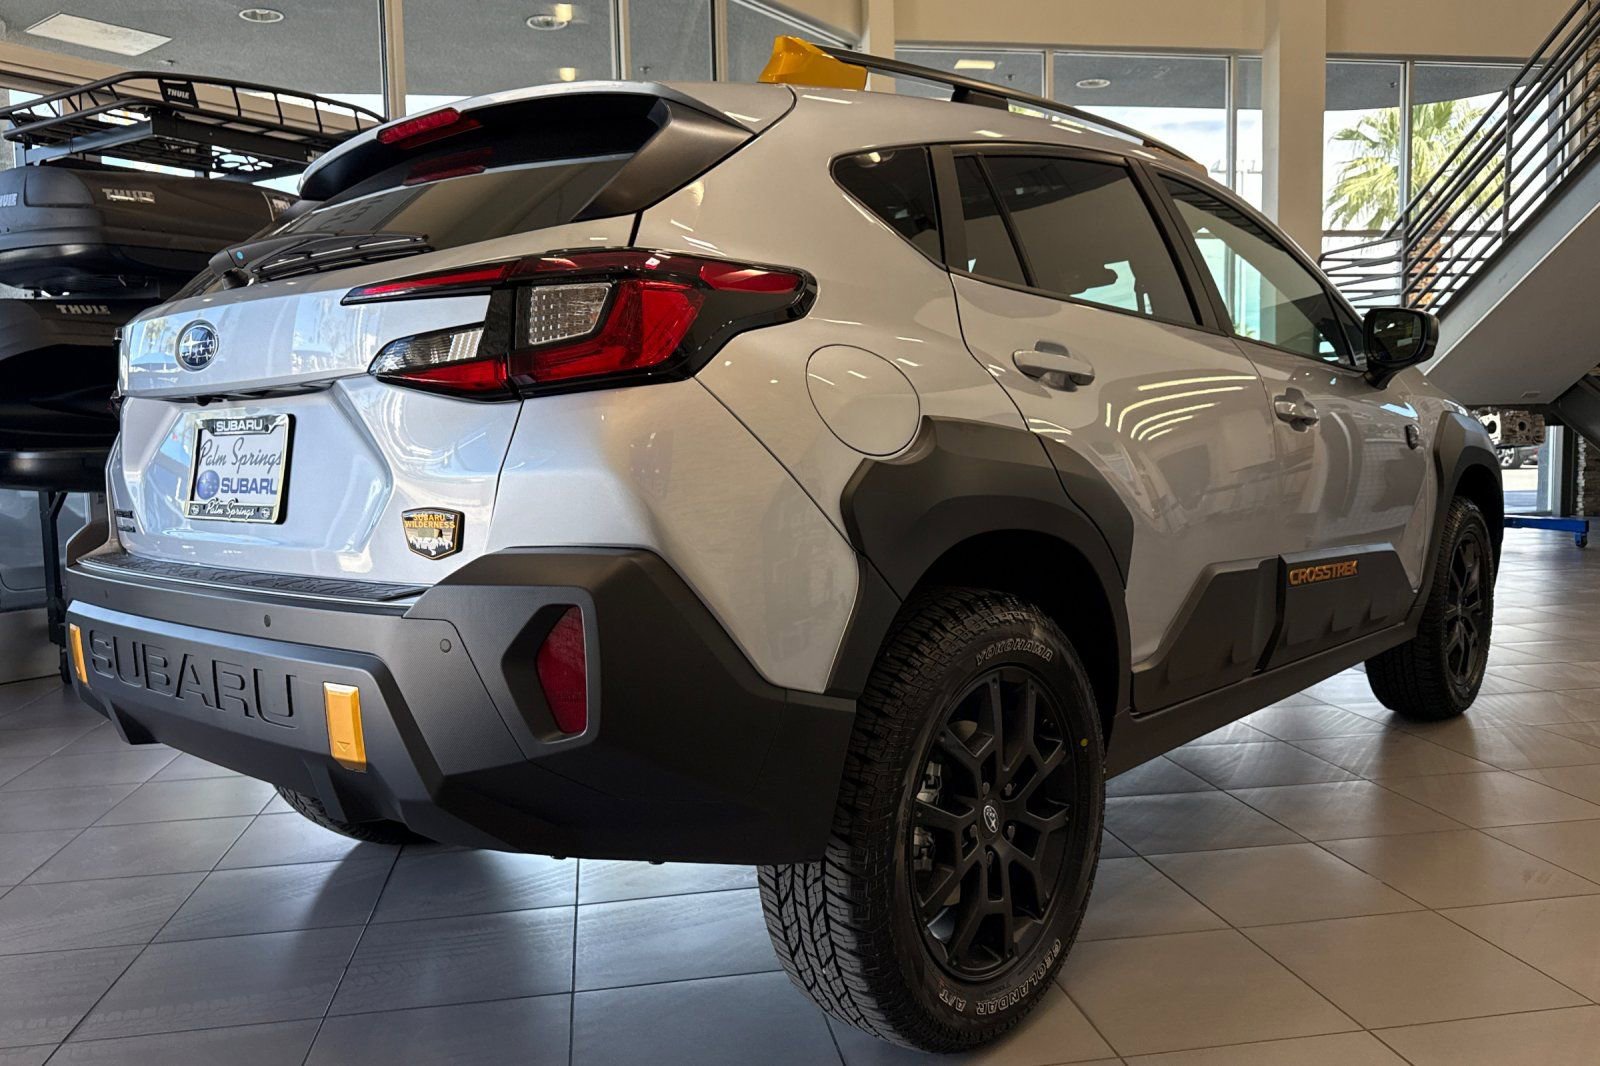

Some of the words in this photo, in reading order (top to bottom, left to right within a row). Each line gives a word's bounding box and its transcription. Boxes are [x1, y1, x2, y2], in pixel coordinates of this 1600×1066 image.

[167, 87, 190, 100] THULE
[56, 304, 110, 315] THULE
[216, 419, 263, 432] SUBARU
[200, 438, 227, 466] Palm
[231, 436, 282, 475] Springs
[206, 500, 224, 516] Palm
[226, 500, 255, 519] Springs
[413, 513, 446, 522] SUBARU
[403, 520, 456, 529] WILDERNESS
[1289, 560, 1358, 586] CROSSTREK
[976, 638, 1054, 667] YOKOHAMA
[89, 629, 298, 730] SUBARU
[976, 938, 1061, 1016] GEOLANDAR
